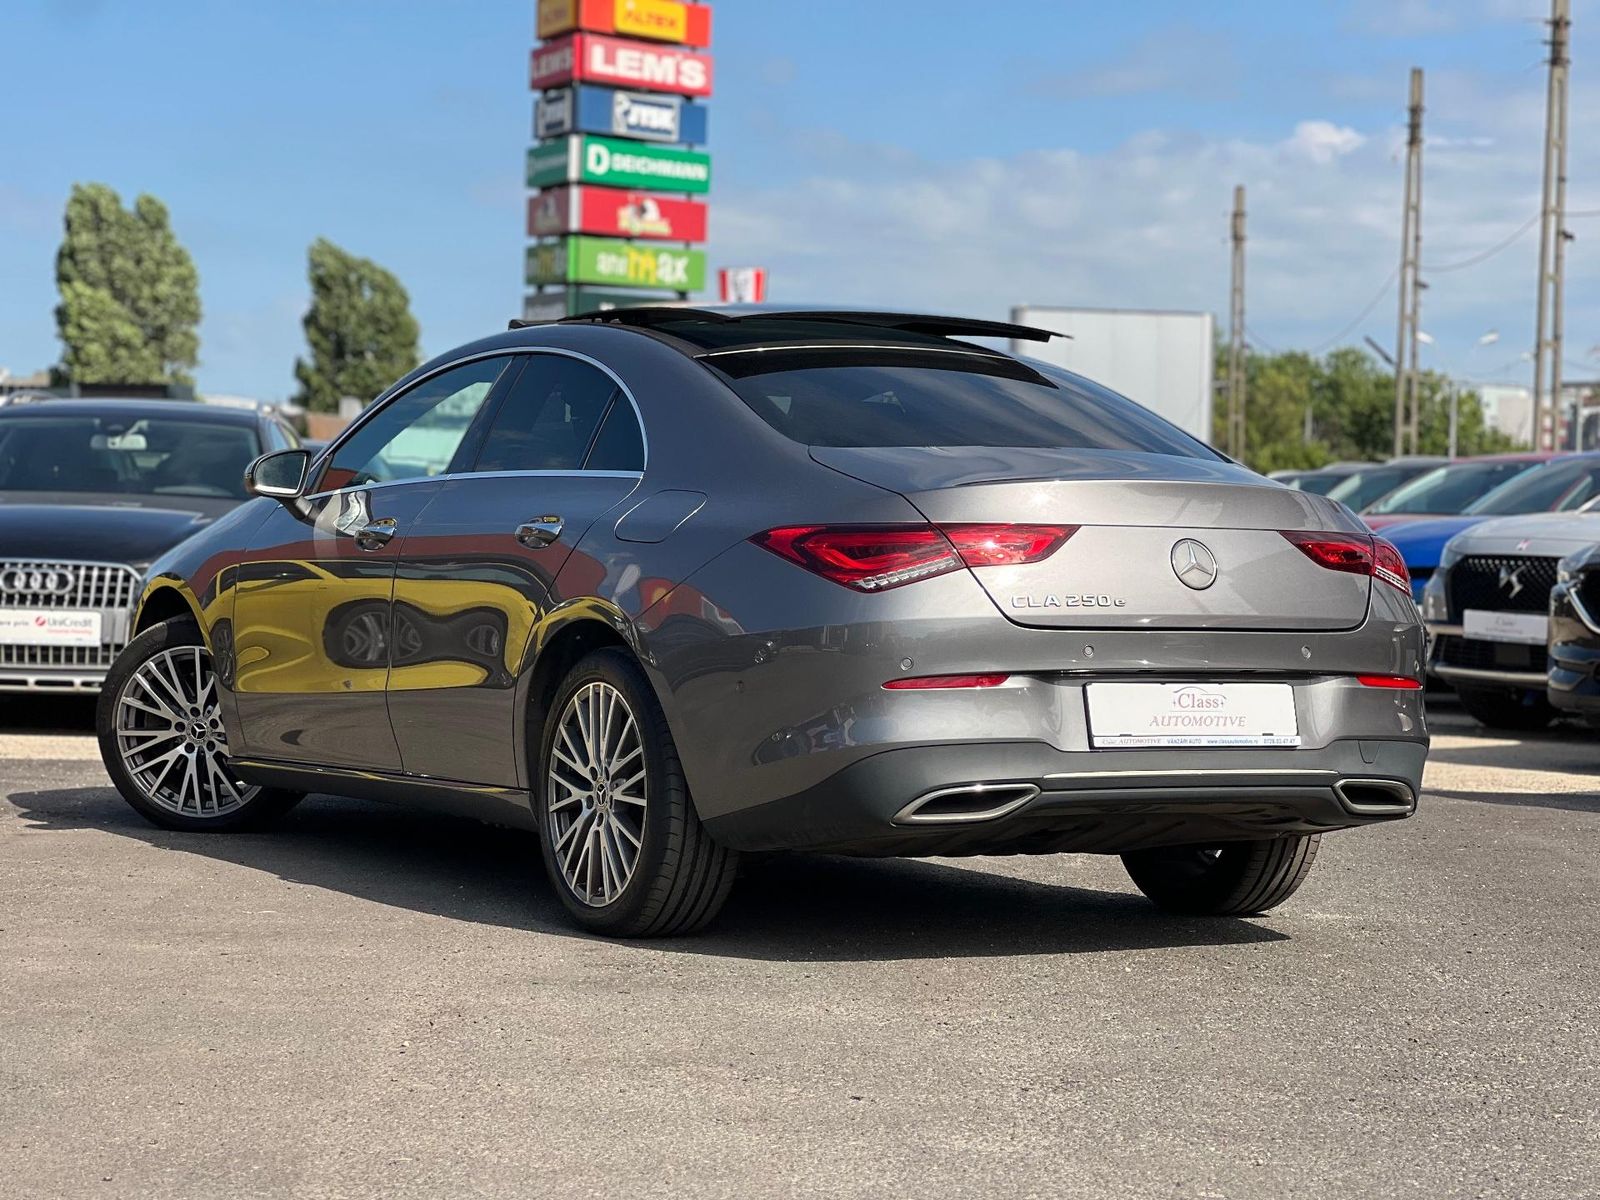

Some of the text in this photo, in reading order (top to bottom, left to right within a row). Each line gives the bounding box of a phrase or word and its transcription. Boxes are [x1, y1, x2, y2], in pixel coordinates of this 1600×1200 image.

[590, 45, 707, 88] LEM'S
[611, 153, 708, 181] DEICHMANN
[1011, 594, 1126, 608] CLA 250e
[48, 617, 92, 627] UniCredit
[1178, 693, 1219, 708] Class
[1149, 715, 1247, 727] AUTOMOTIVE
